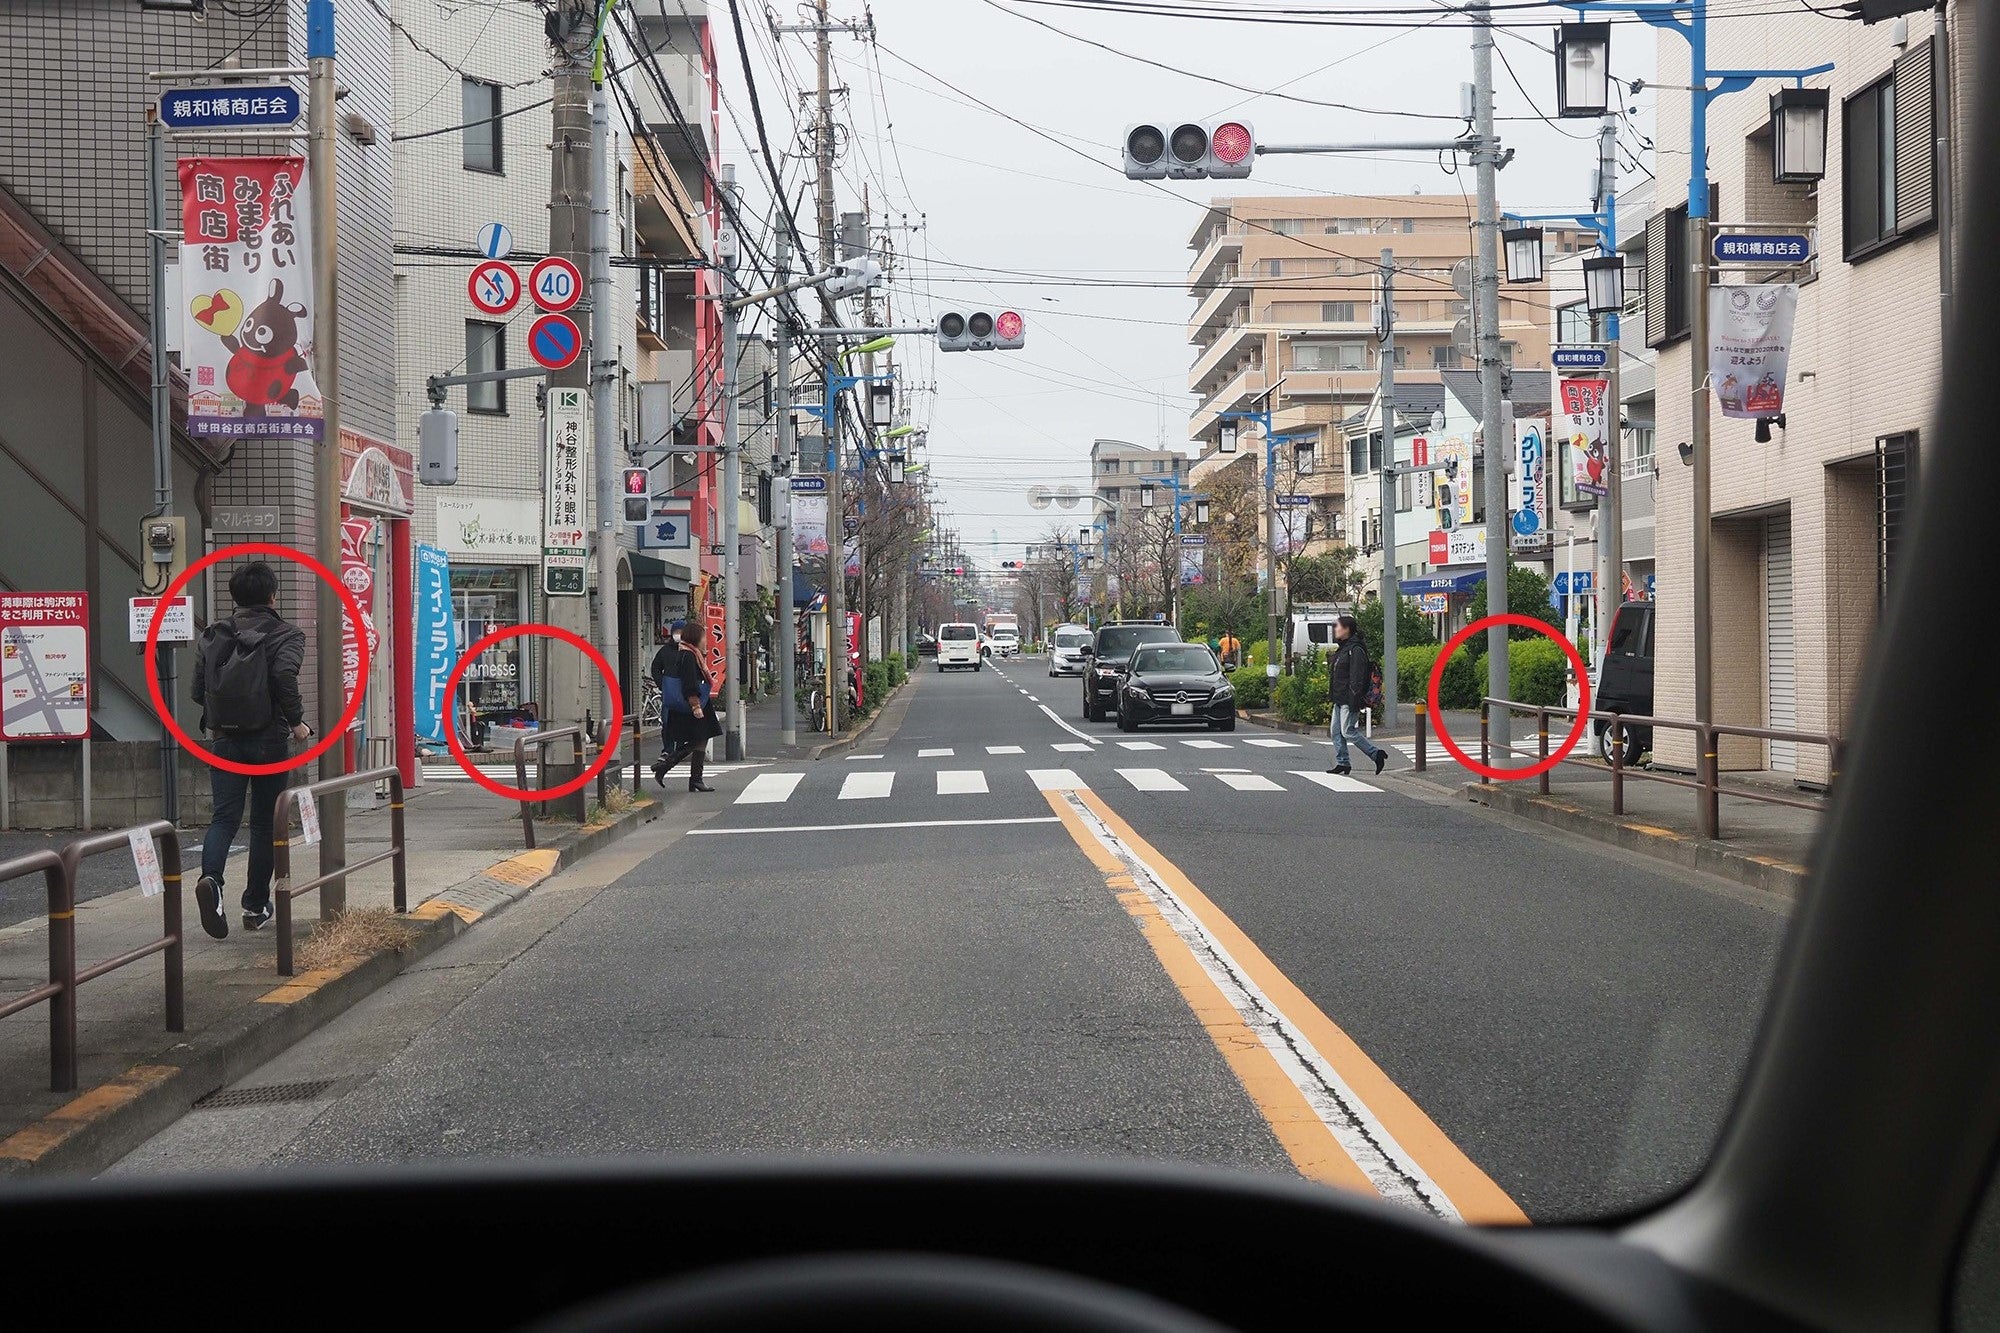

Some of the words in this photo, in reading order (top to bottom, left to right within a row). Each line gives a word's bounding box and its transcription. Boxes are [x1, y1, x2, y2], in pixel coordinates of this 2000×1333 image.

[173, 97, 287, 117] 親和橋商店会
[196, 174, 229, 273] 商店街
[234, 175, 263, 274] みまもり
[269, 173, 296, 268] ふれあい
[1722, 242, 1801, 256] 親和橋商店会
[541, 274, 570, 296] 40
[1568, 386, 1581, 427] 商店街
[1582, 387, 1595, 426] みまもり
[197, 422, 314, 435] 世田谷区商店街連合会
[564, 421, 578, 526] 神谷整形外科・眼科
[1522, 437, 1535, 511] クリーニン
[1, 609, 81, 620] をご利用下さい。
